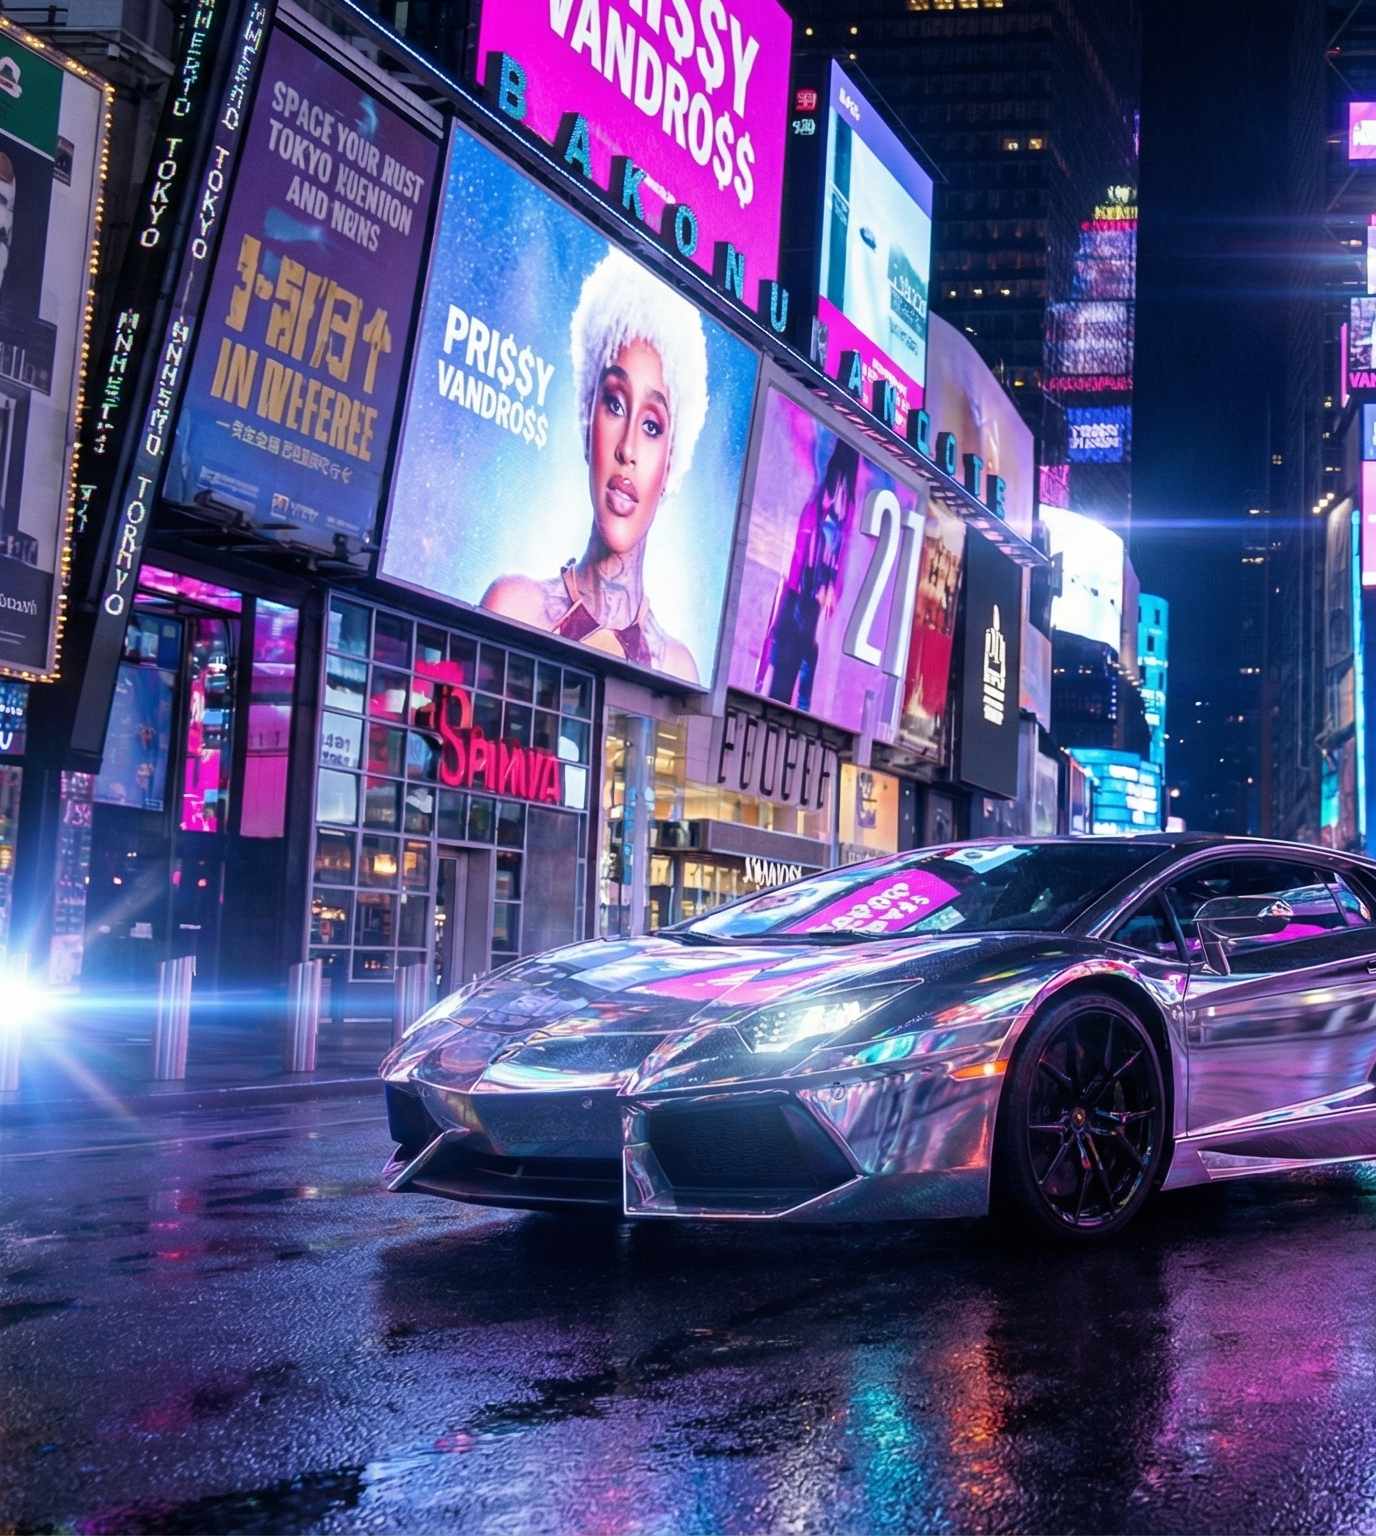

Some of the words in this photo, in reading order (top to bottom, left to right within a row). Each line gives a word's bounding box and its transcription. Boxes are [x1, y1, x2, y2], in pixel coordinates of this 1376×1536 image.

[268, 118, 333, 184] TOKYO
[272, 80, 335, 146] SPACE
[336, 122, 380, 178] YOUR
[140, 138, 183, 248] TOKYO
[191, 145, 230, 260] TOKYO
[286, 175, 329, 221] AND
[210, 335, 259, 410] IN
[444, 304, 556, 407] PRI$$Y
[437, 360, 550, 451] VANDRO$$
[850, 489, 925, 679] 21
